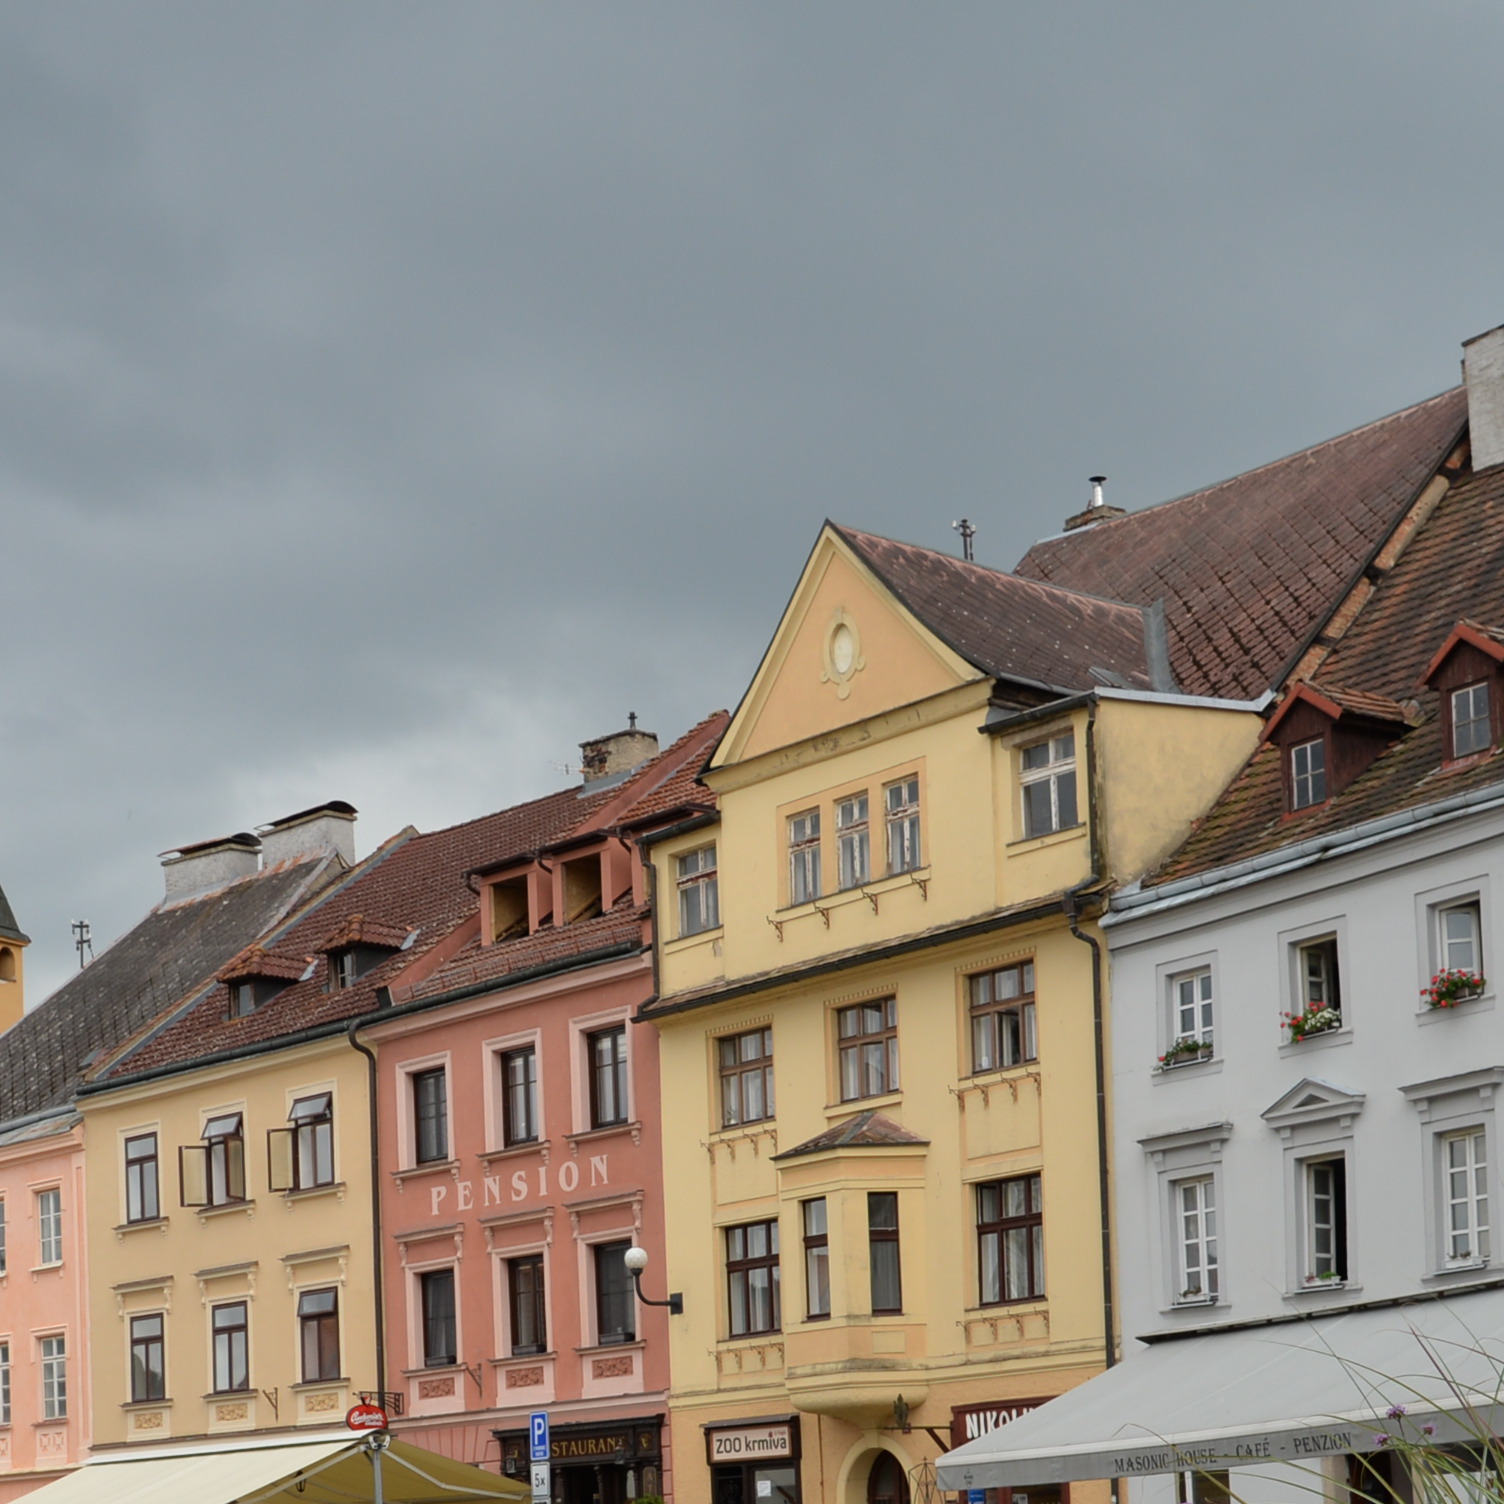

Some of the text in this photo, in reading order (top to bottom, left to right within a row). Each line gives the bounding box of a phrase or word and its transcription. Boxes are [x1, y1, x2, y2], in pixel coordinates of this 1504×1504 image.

[430, 1154, 610, 1216] PENSION
[534, 1418, 544, 1445] P
[716, 1434, 787, 1454] ZOO krmiva
[1114, 1453, 1169, 1473] MASONIC
[1177, 1448, 1217, 1467] HOUSE
[1236, 1438, 1271, 1460] CAFÉ
[1293, 1432, 1352, 1454] PENZION
[535, 1473, 546, 1488] 5x
